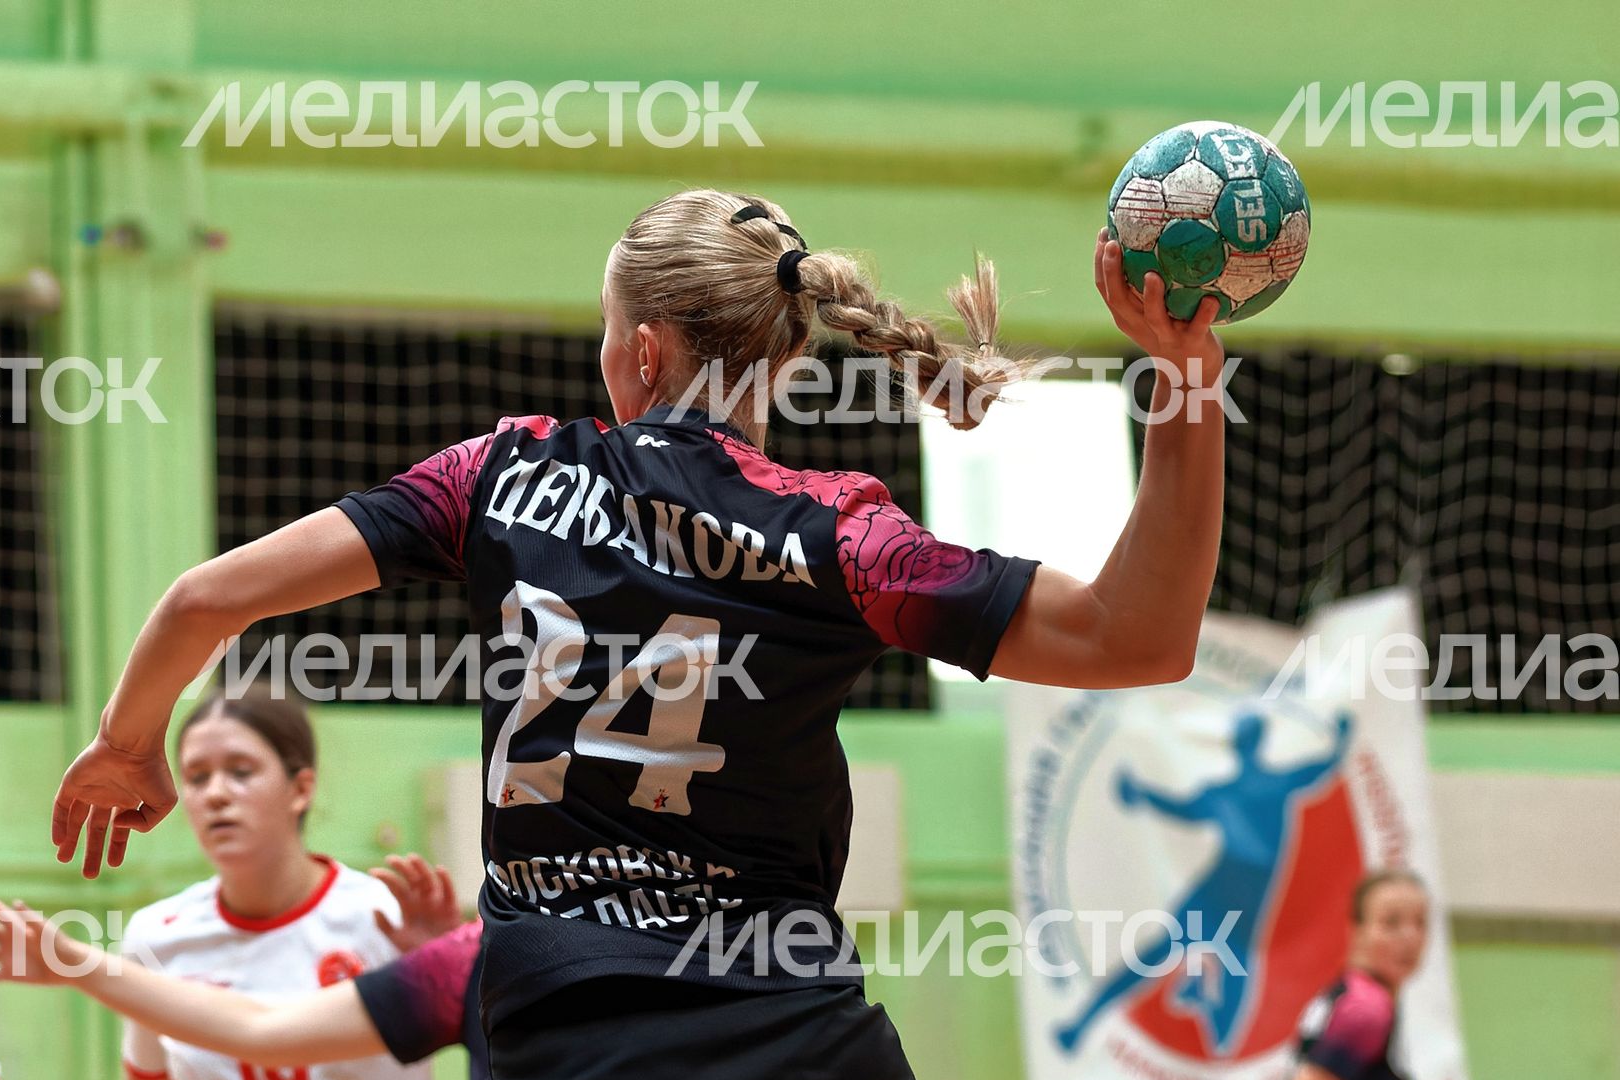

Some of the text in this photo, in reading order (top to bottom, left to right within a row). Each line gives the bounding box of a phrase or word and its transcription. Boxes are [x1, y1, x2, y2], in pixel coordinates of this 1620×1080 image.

[1209, 132, 1267, 242] SELECT
[487, 579, 726, 817] 24
[486, 843, 741, 903] ОСКОВСК
[539, 883, 743, 930] ЛАСТЬ
